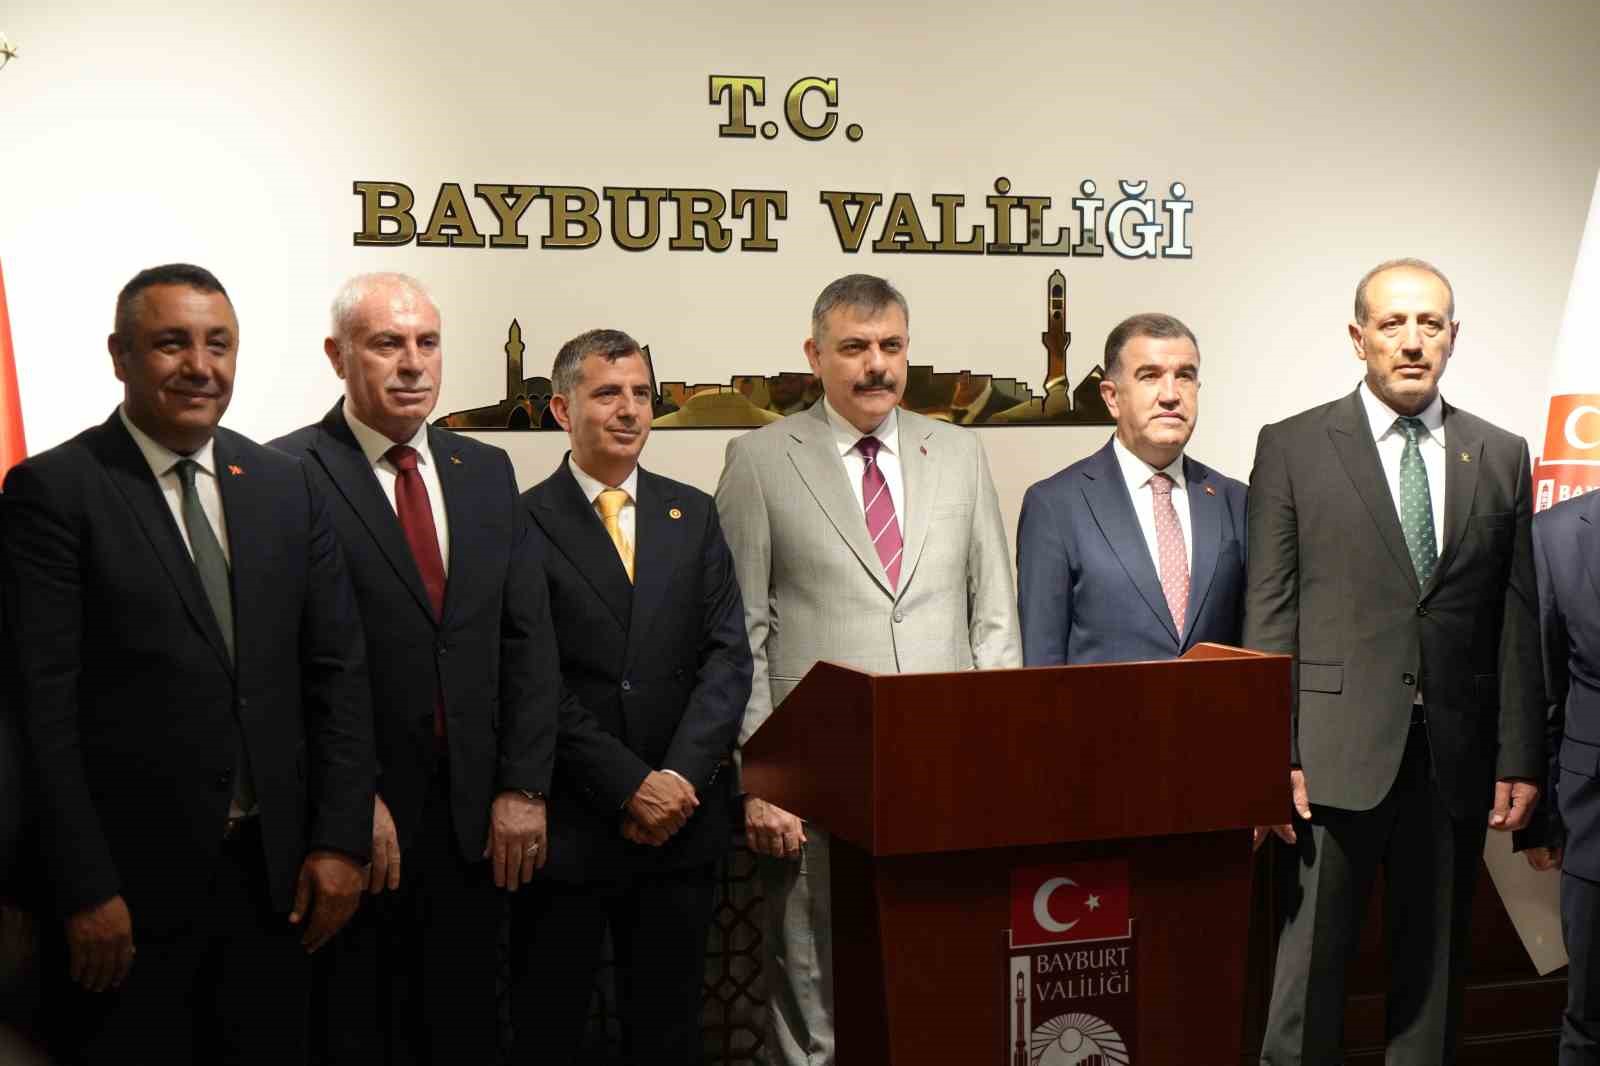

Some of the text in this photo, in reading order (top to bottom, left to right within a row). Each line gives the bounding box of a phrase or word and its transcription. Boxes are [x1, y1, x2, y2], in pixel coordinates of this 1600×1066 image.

[353, 177, 1192, 259] BAYBURT VALİLİĞİ
[1037, 948, 1129, 973] BAYBURT
[1036, 971, 1129, 1000] VALİLİĞİ
